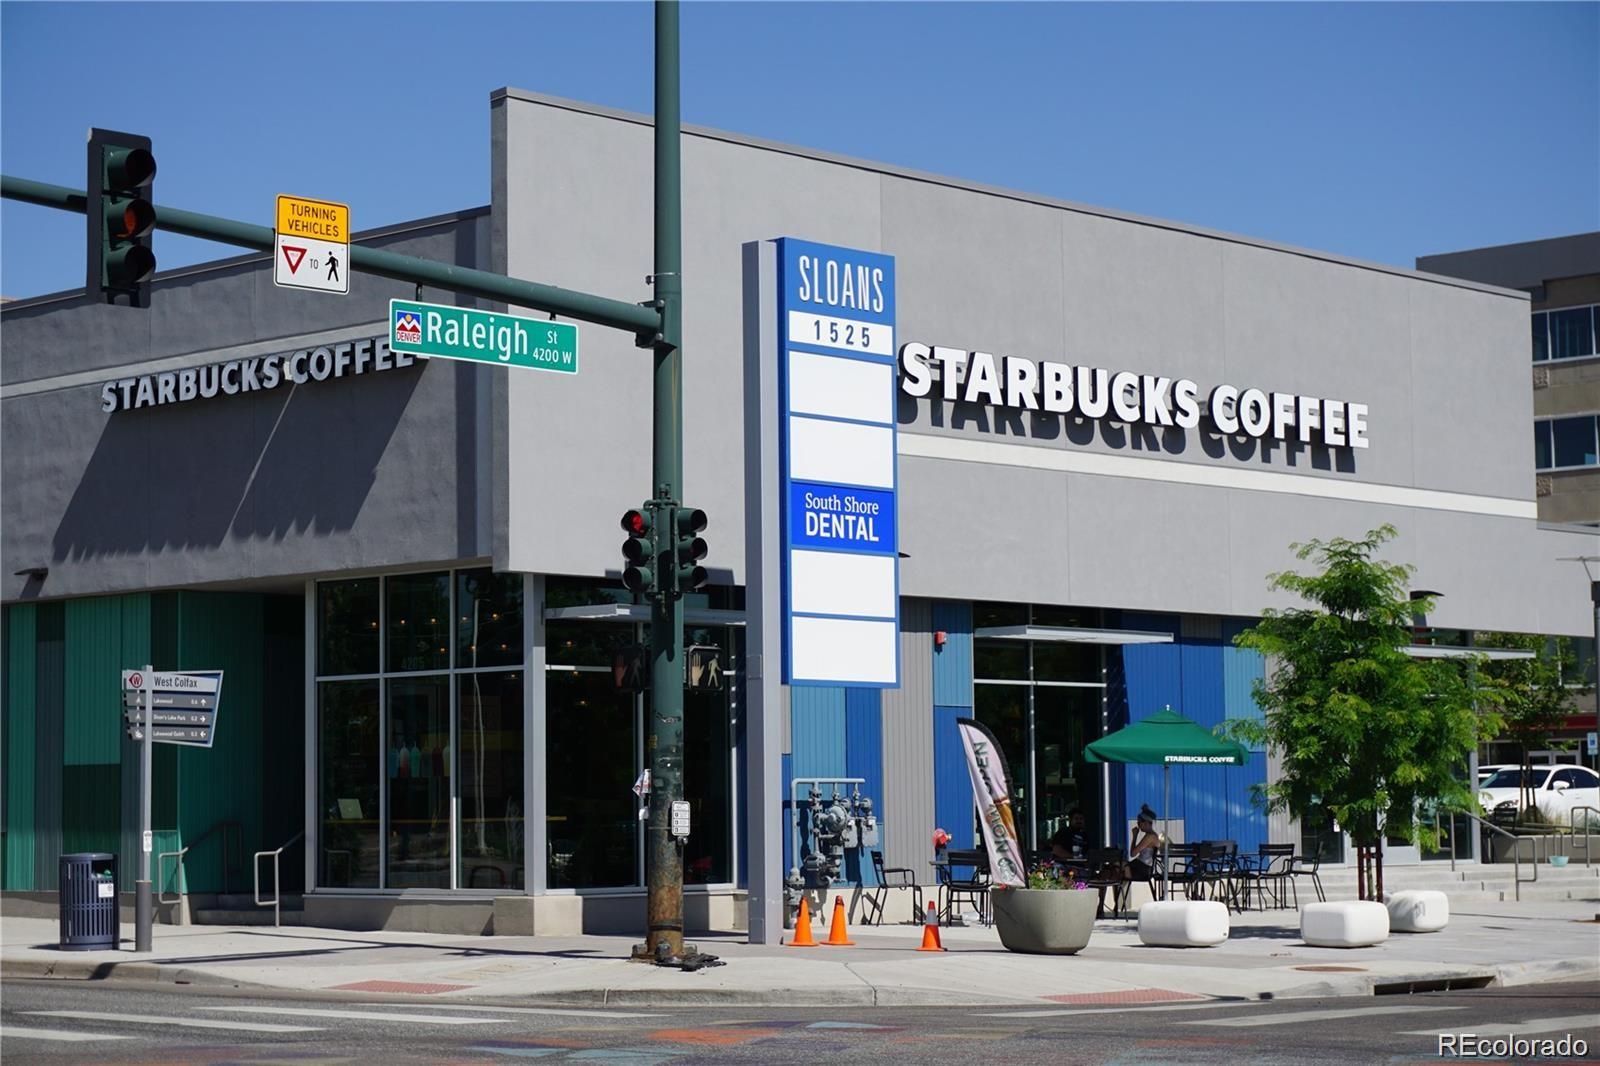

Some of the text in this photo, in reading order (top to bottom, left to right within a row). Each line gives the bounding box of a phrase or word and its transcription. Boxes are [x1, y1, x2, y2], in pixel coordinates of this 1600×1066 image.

[290, 203, 337, 221] TURNING
[288, 219, 339, 237] VEHICLES
[309, 258, 319, 270] TO
[799, 255, 884, 313] SLOANS
[397, 331, 421, 343] DENVER
[427, 311, 558, 361] Raleigh St
[814, 319, 870, 348] 1525
[532, 347, 572, 365] 4200 W
[102, 354, 281, 413] STARBUCKS
[898, 341, 1369, 449] STARBUCKS COFFEE
[805, 492, 879, 515] South Shore
[805, 511, 880, 542] DENTAL
[133, 675, 141, 686] W
[153, 676, 198, 688] West Colfax
[1164, 755, 1207, 763] STARBUCKS
[989, 804, 1009, 853] NOW
